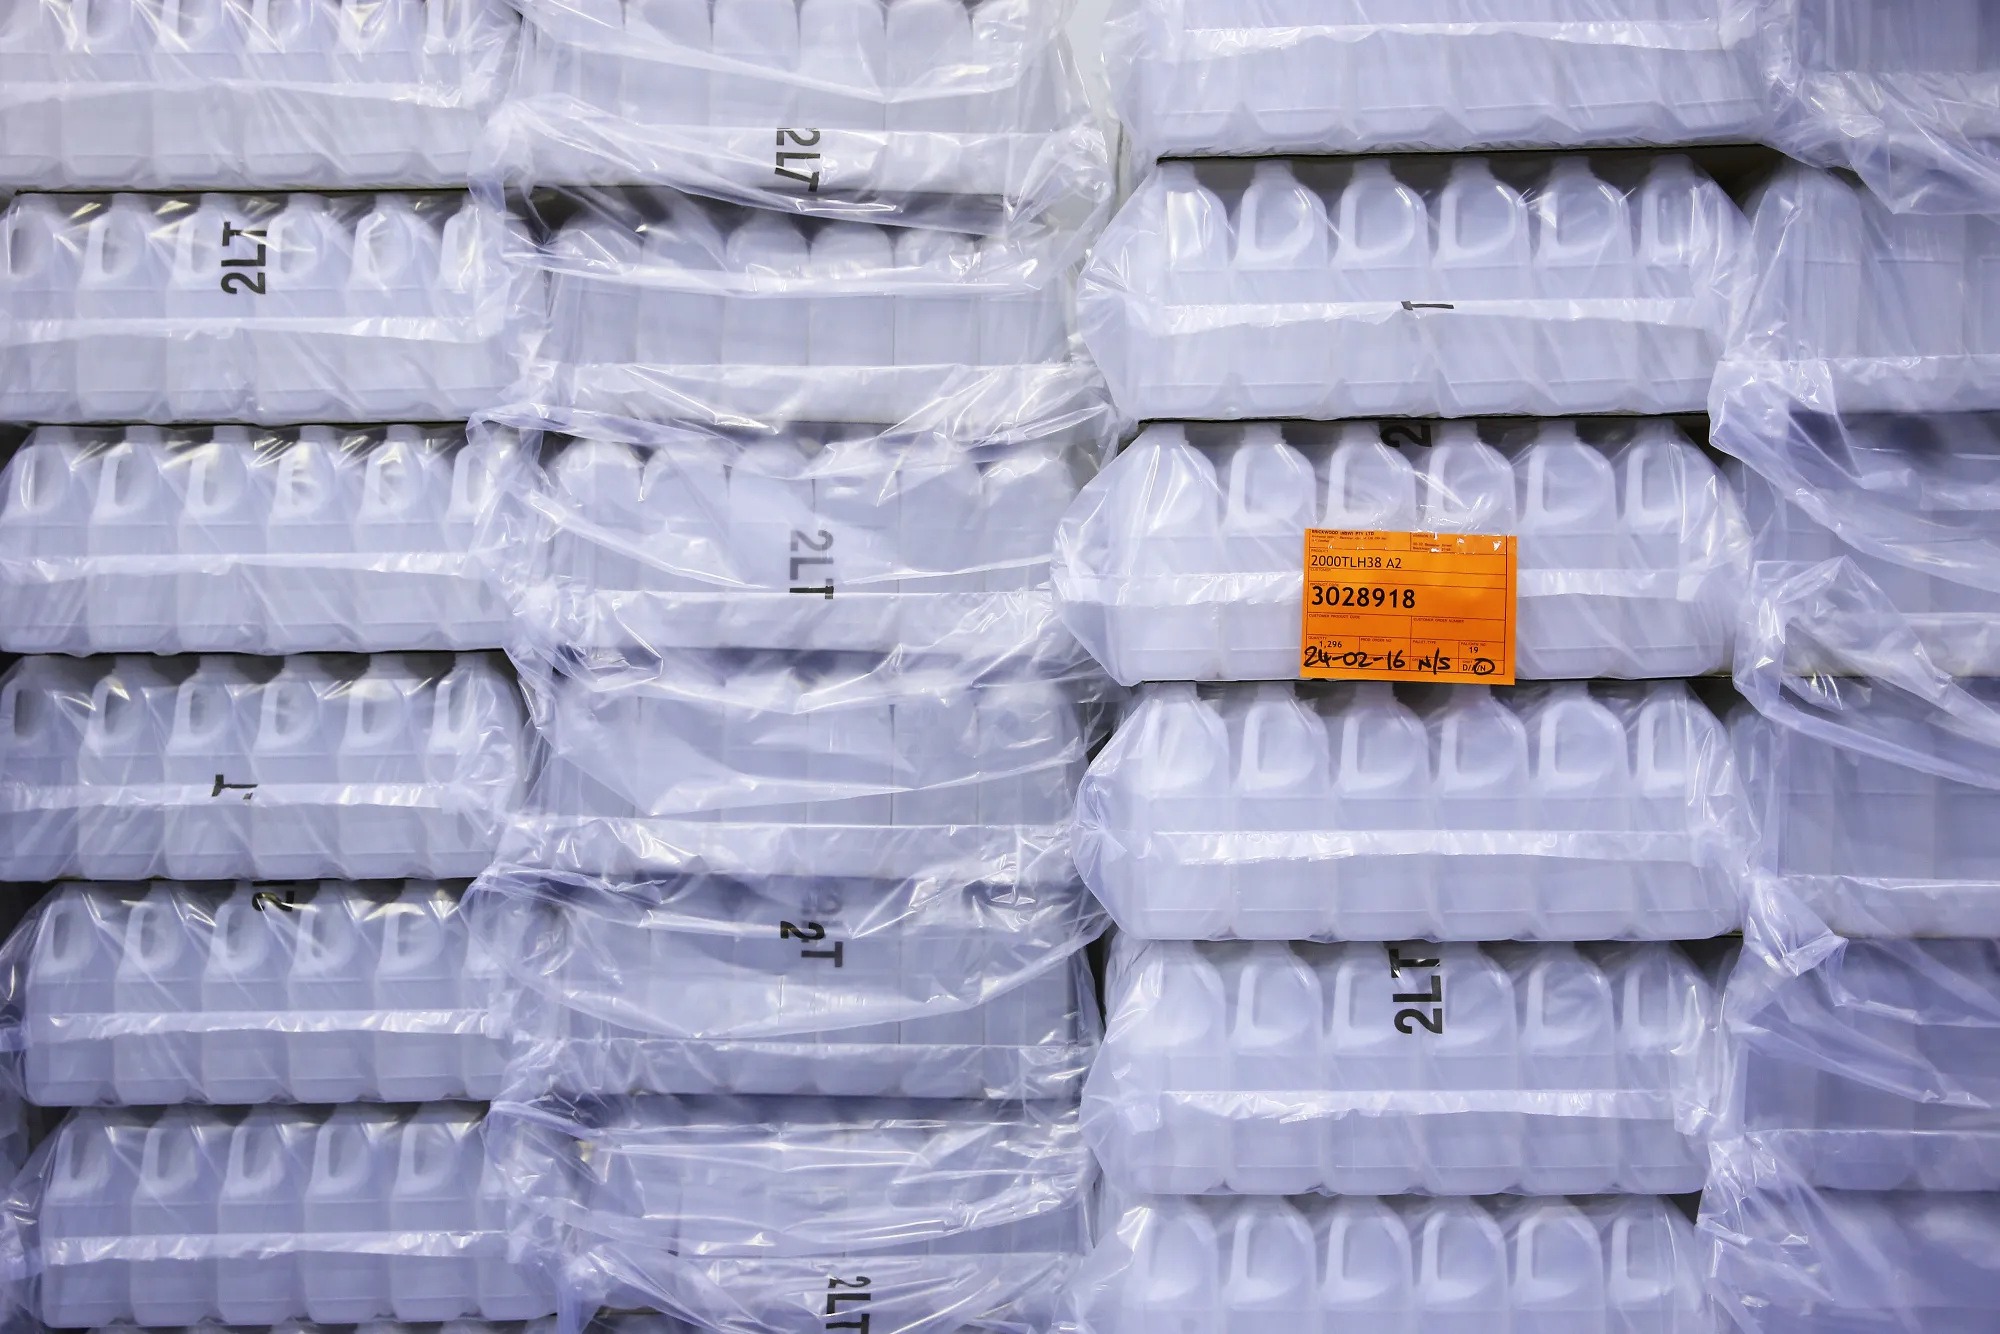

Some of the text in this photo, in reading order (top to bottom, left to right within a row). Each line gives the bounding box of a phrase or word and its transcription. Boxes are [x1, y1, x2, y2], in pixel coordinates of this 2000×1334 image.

[221, 221, 267, 294] 2LT
[789, 529, 834, 600] 2LT
[1311, 555, 1402, 569] 2000TLH38 A2
[1311, 585, 1415, 609] 3028918
[1319, 640, 1343, 649] 1,296
[1469, 646, 1479, 654] 19
[1388, 948, 1443, 1034] 2LT
[825, 1275, 872, 1334] 2LT
